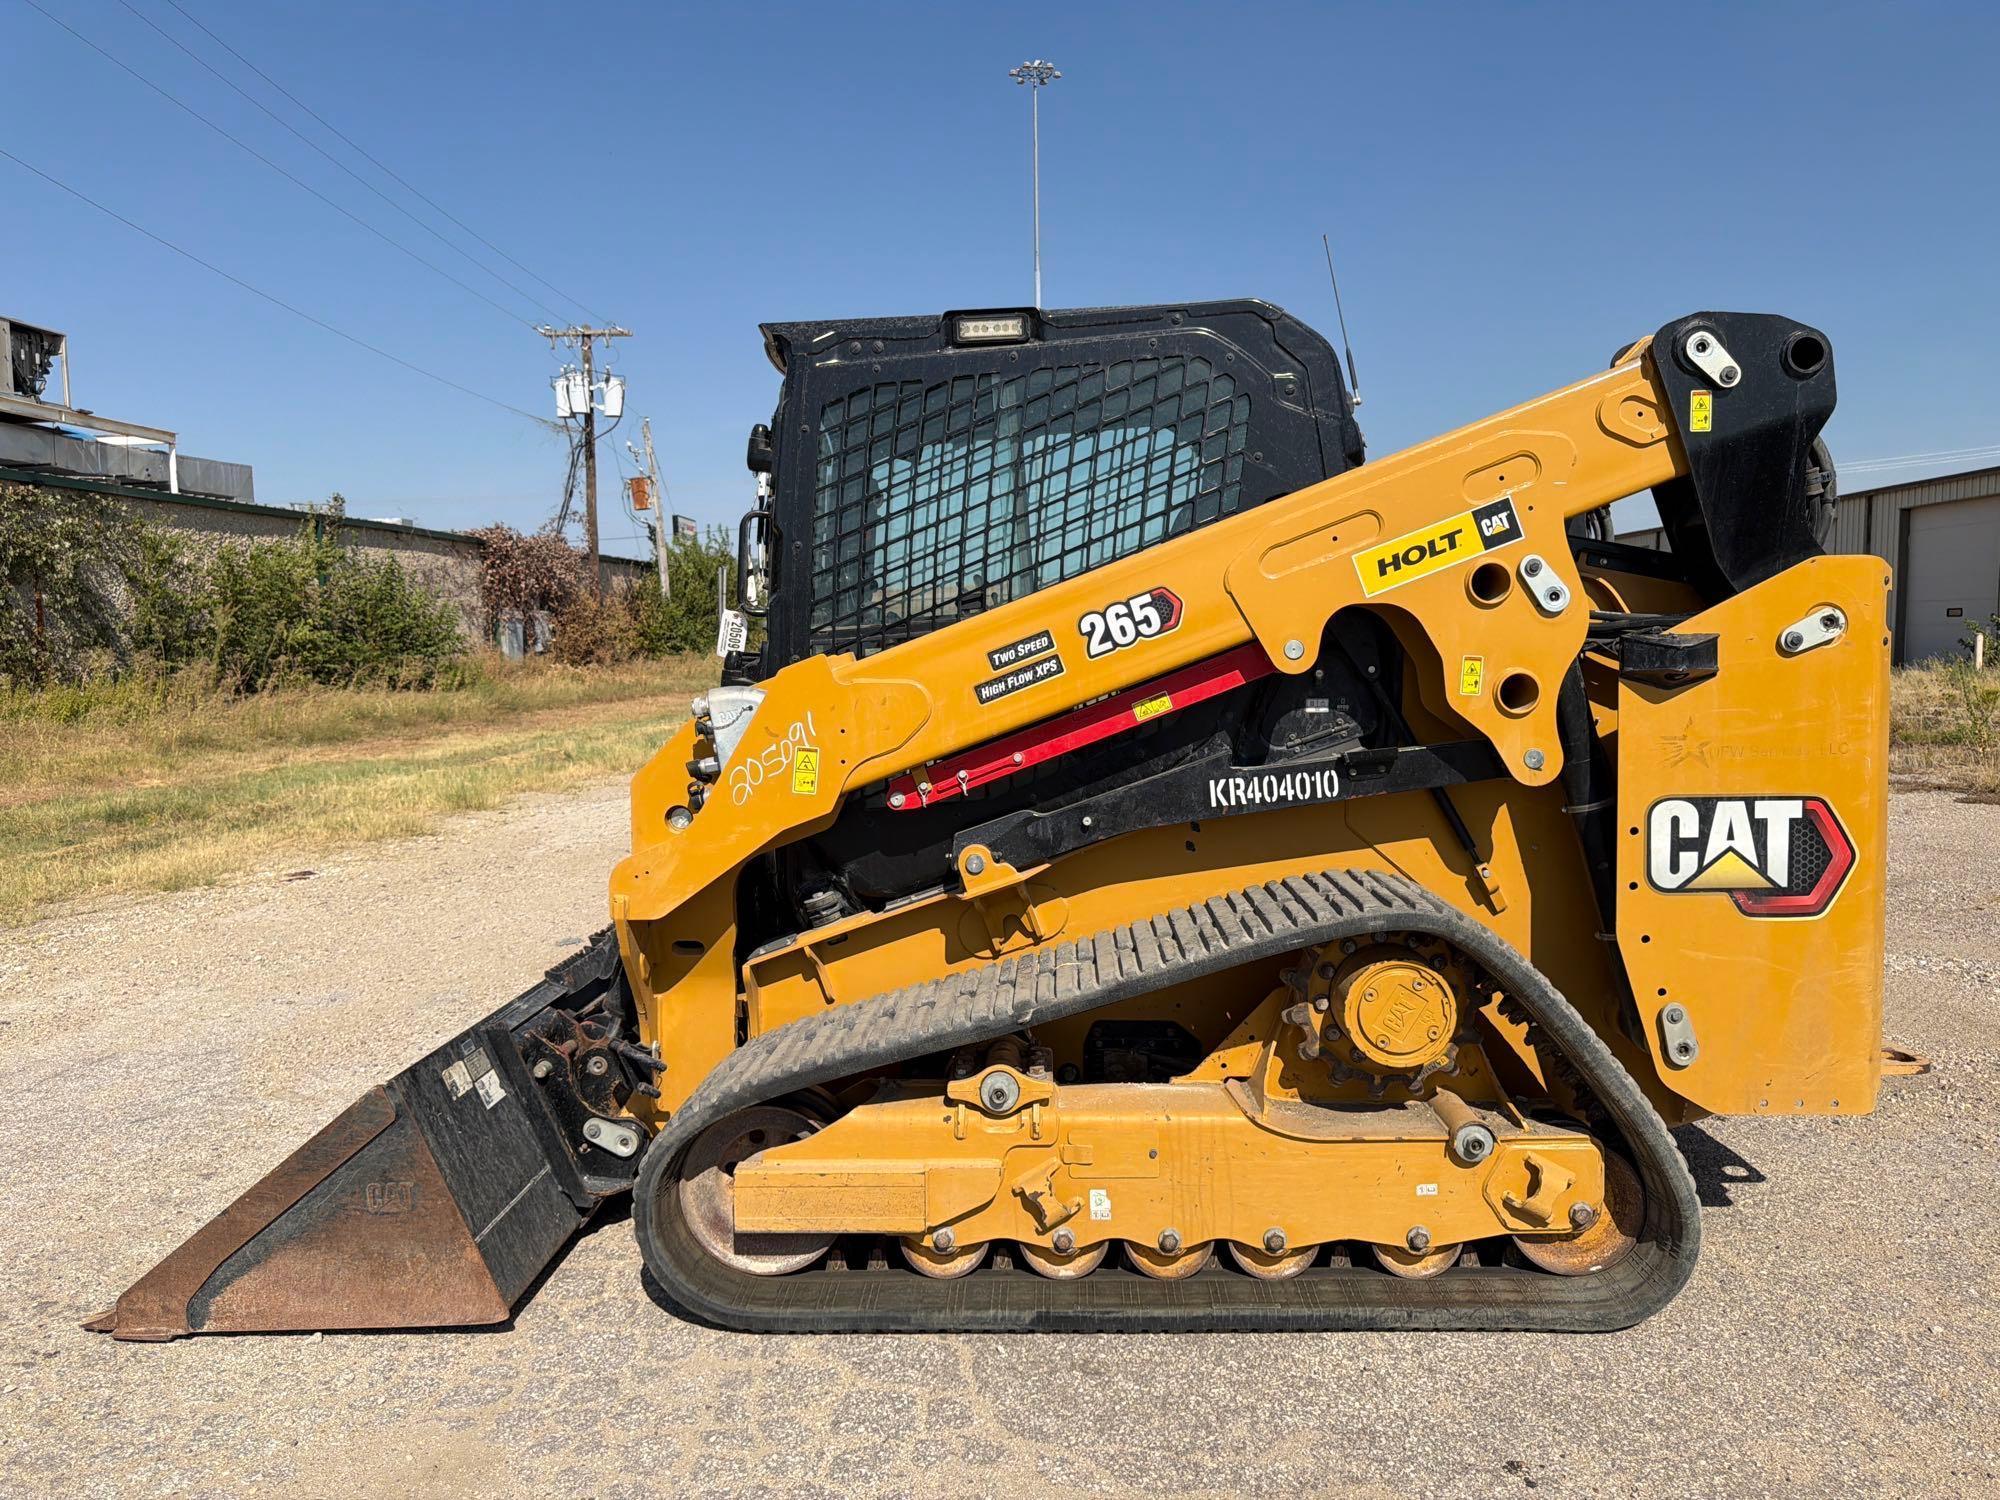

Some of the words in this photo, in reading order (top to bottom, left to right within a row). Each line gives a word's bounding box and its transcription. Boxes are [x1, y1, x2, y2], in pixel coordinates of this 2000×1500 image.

[1377, 528, 1463, 577] HOLT
[1480, 511, 1510, 537] CAT
[1080, 593, 1161, 656] 265
[1035, 659, 1058, 677] XPS
[729, 711, 816, 806] 205091
[1208, 769, 1339, 808] KR404010
[1650, 799, 1803, 889] CAT
[1382, 1001, 1417, 1034] CAT
[366, 1181, 415, 1214] CAT
